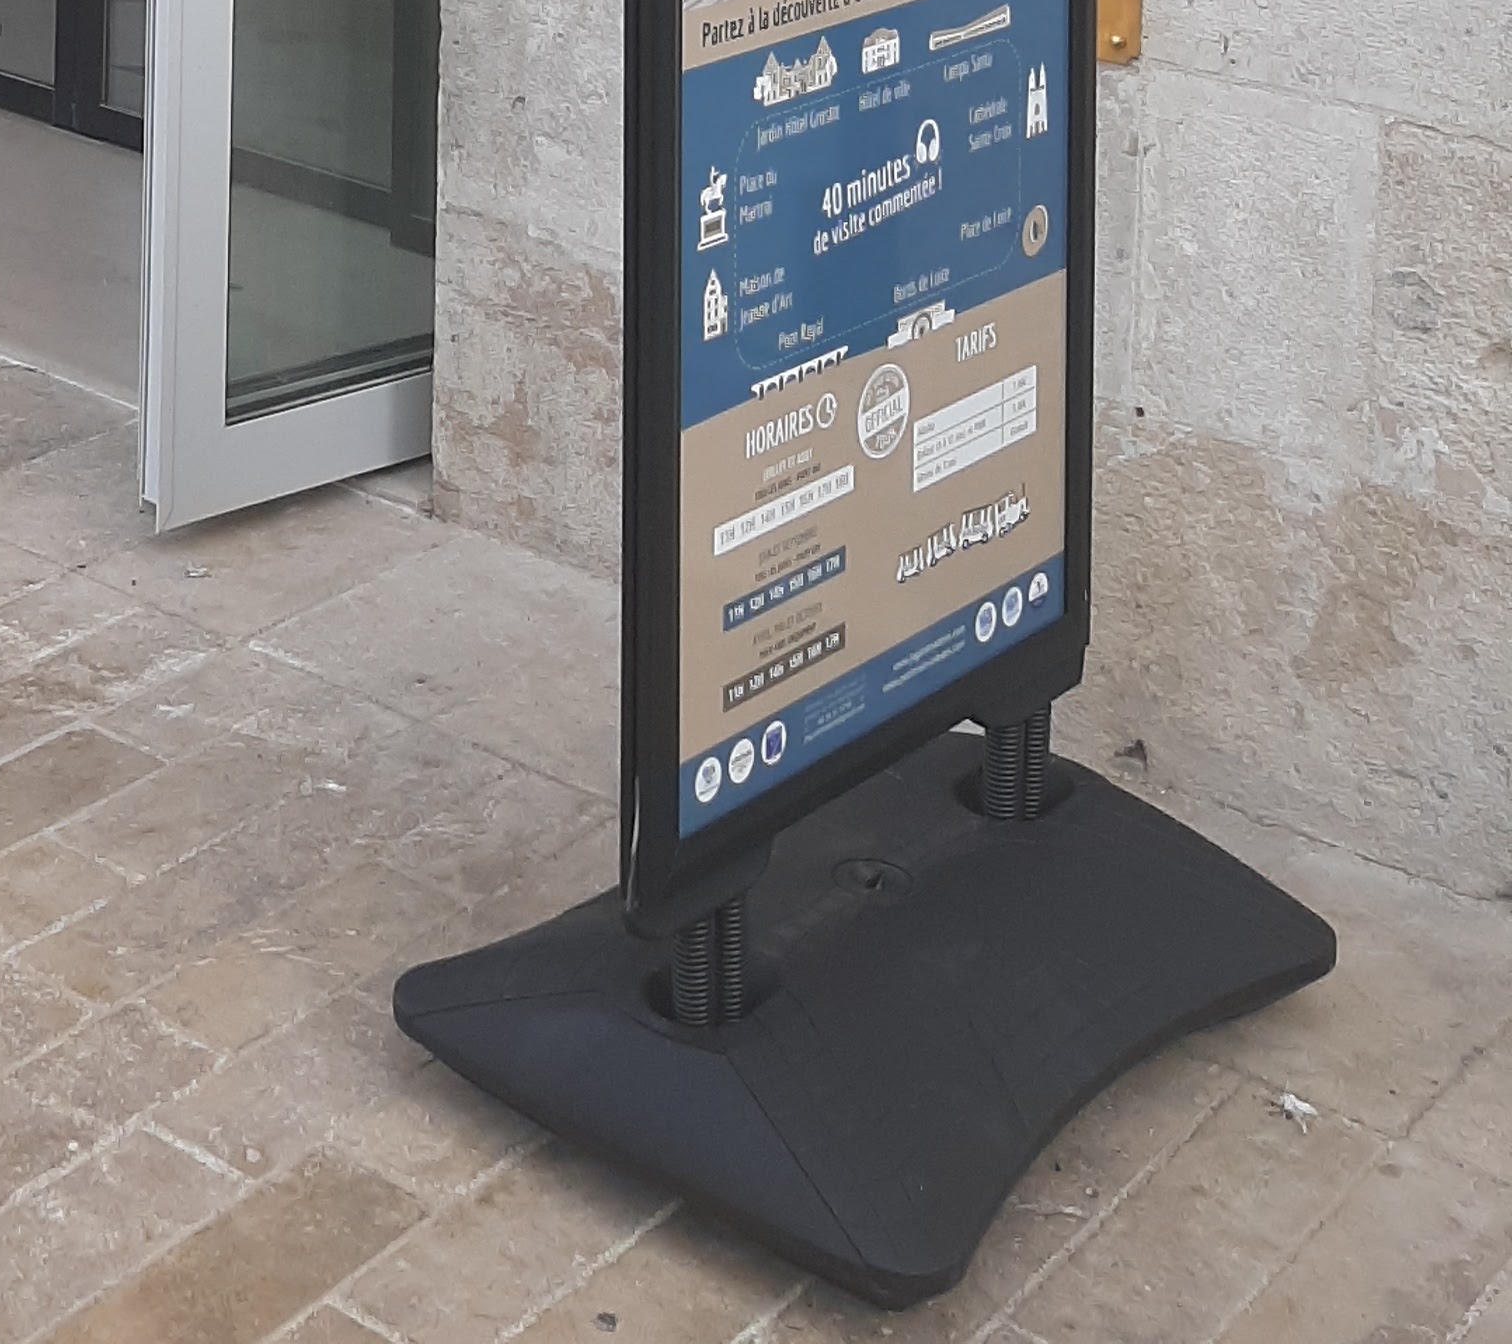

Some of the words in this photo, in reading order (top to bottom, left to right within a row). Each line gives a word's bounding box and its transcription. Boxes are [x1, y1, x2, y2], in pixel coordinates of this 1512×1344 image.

[702, 17, 745, 48] Partez
[748, 7, 755, 35] à
[759, 6, 769, 31] la
[813, 228, 830, 256] de
[831, 210, 866, 245] visite
[868, 172, 937, 227] commentée
[821, 181, 843, 219] 40
[846, 154, 912, 209] minutes
[955, 322, 998, 363] TARIFS
[745, 404, 815, 460] HORAIRES
